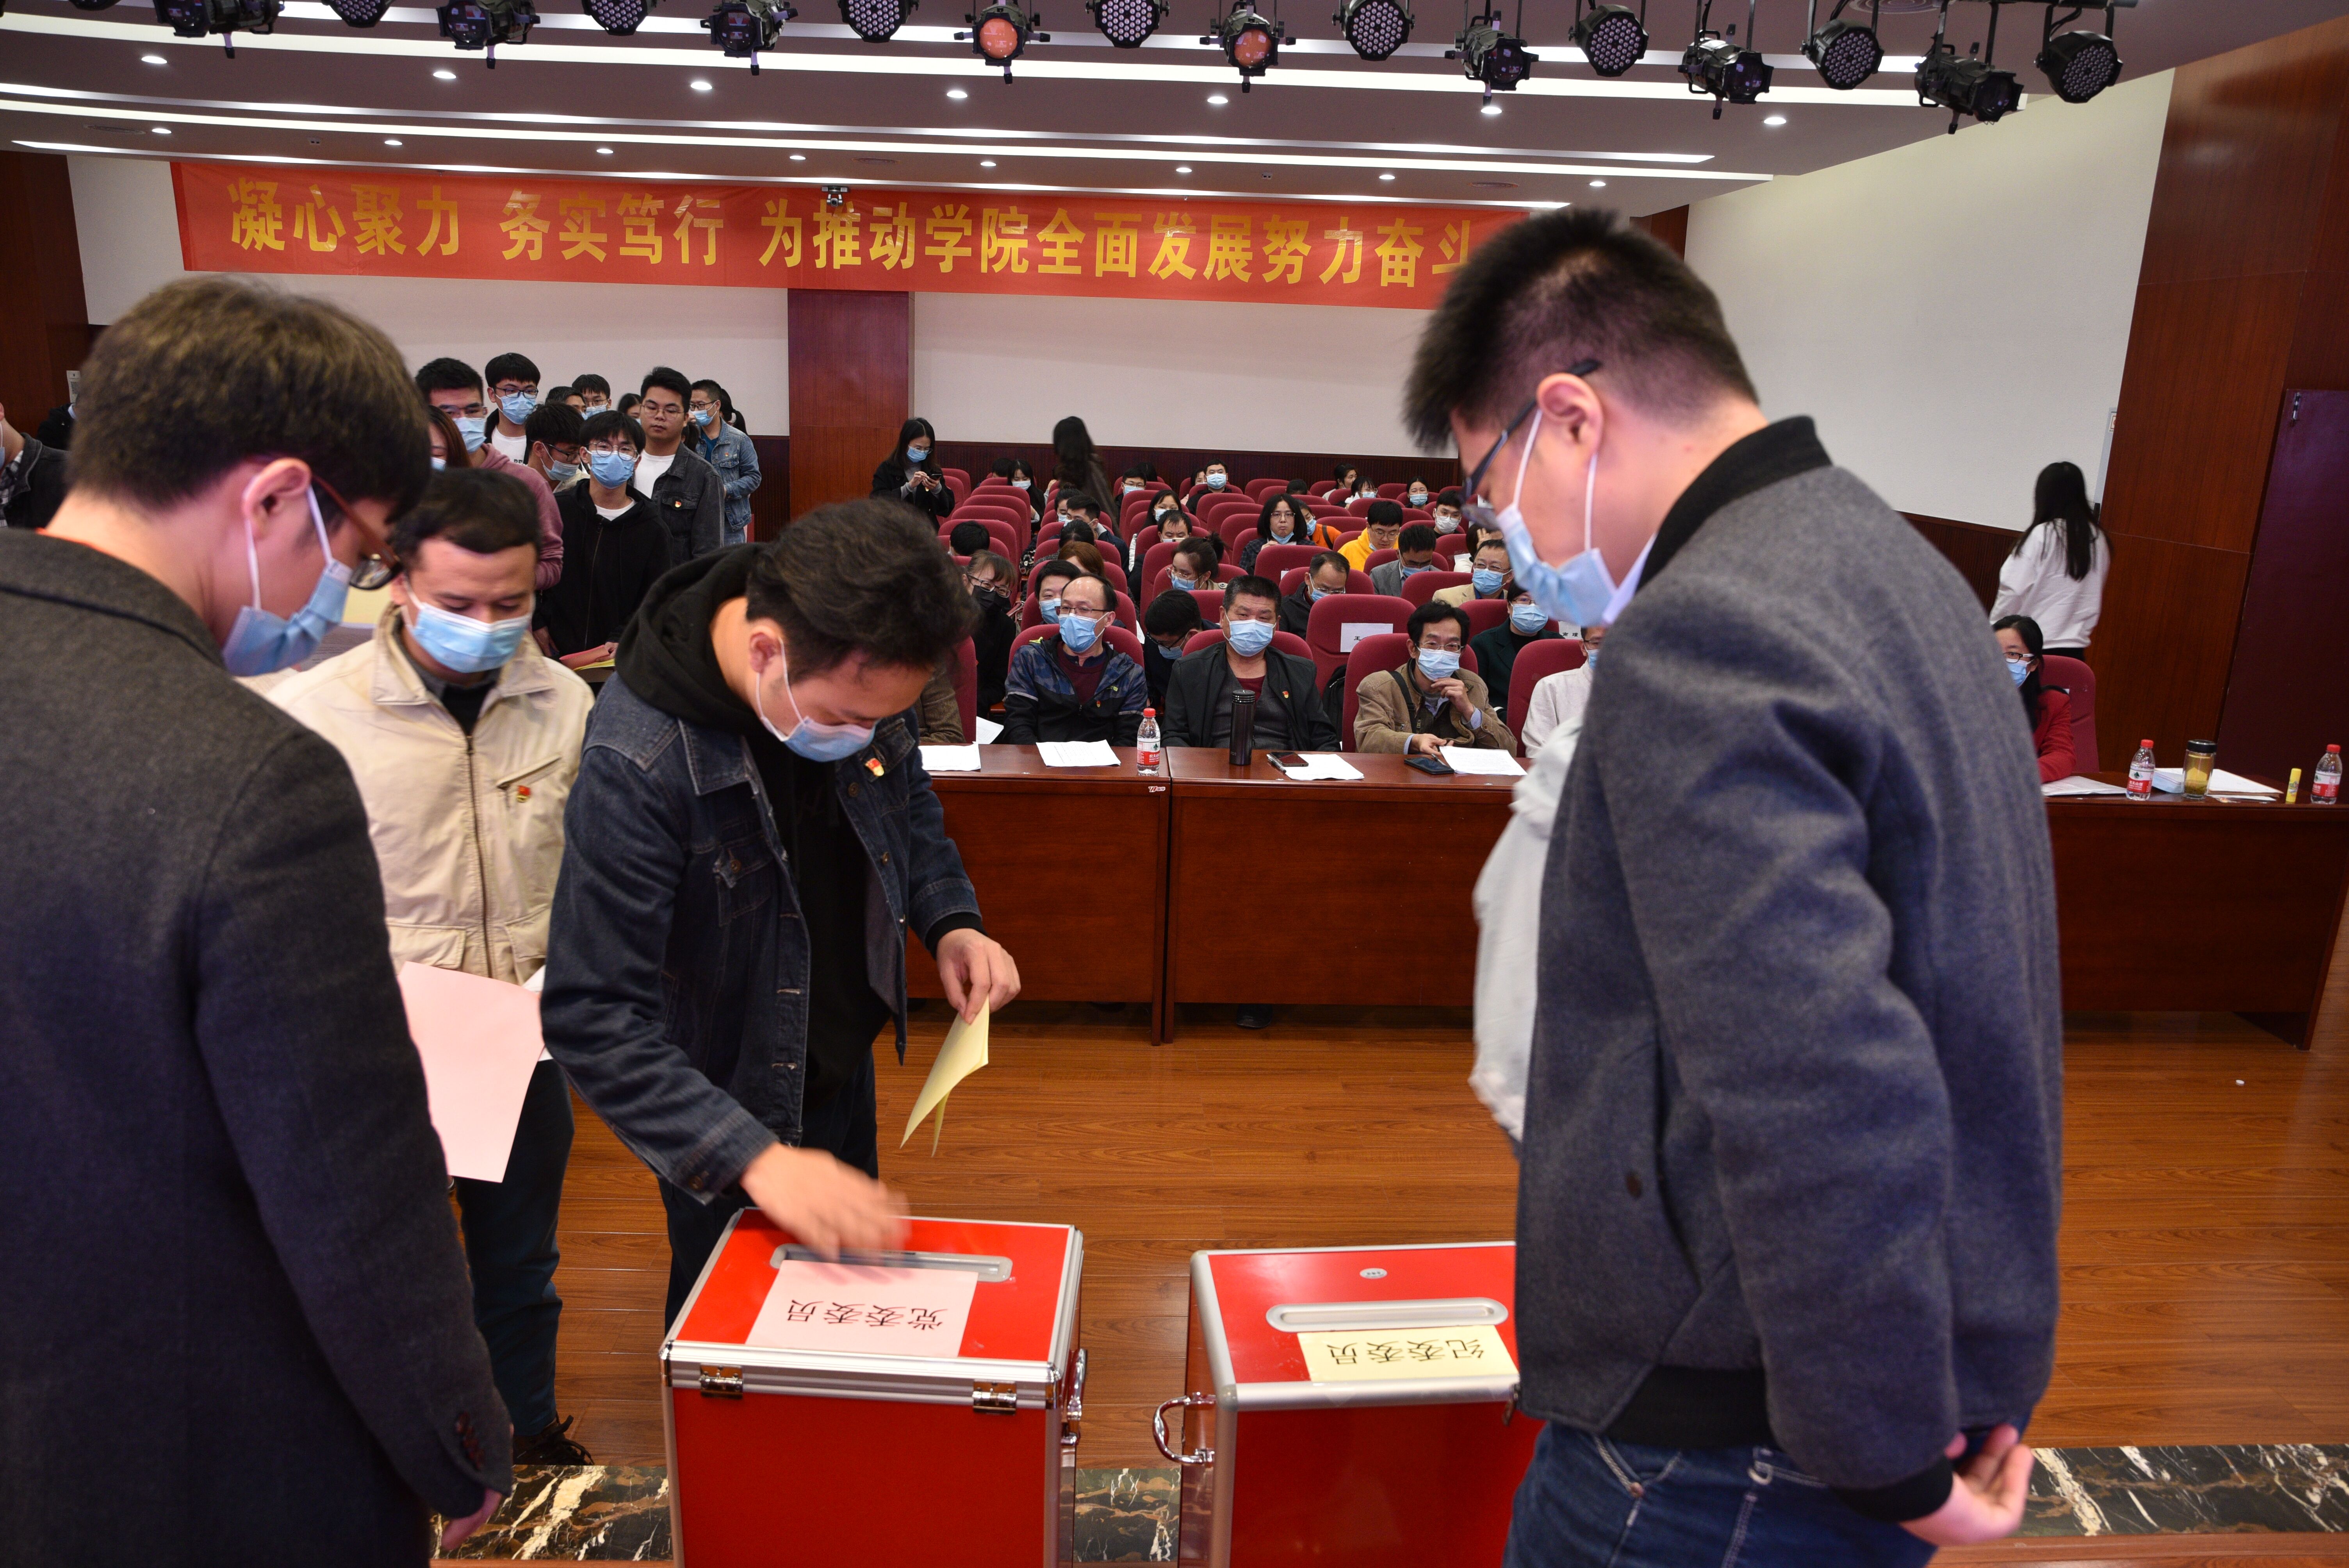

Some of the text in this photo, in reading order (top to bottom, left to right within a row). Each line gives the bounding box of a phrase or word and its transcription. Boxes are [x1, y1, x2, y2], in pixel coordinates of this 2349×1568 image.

[228, 177, 1471, 288] 凝心聚力 务实笃行 为推动学院全面发展努力奋斗
[787, 1299, 948, 1331] 党委委员
[1327, 1339, 1484, 1365] 纪委委员
